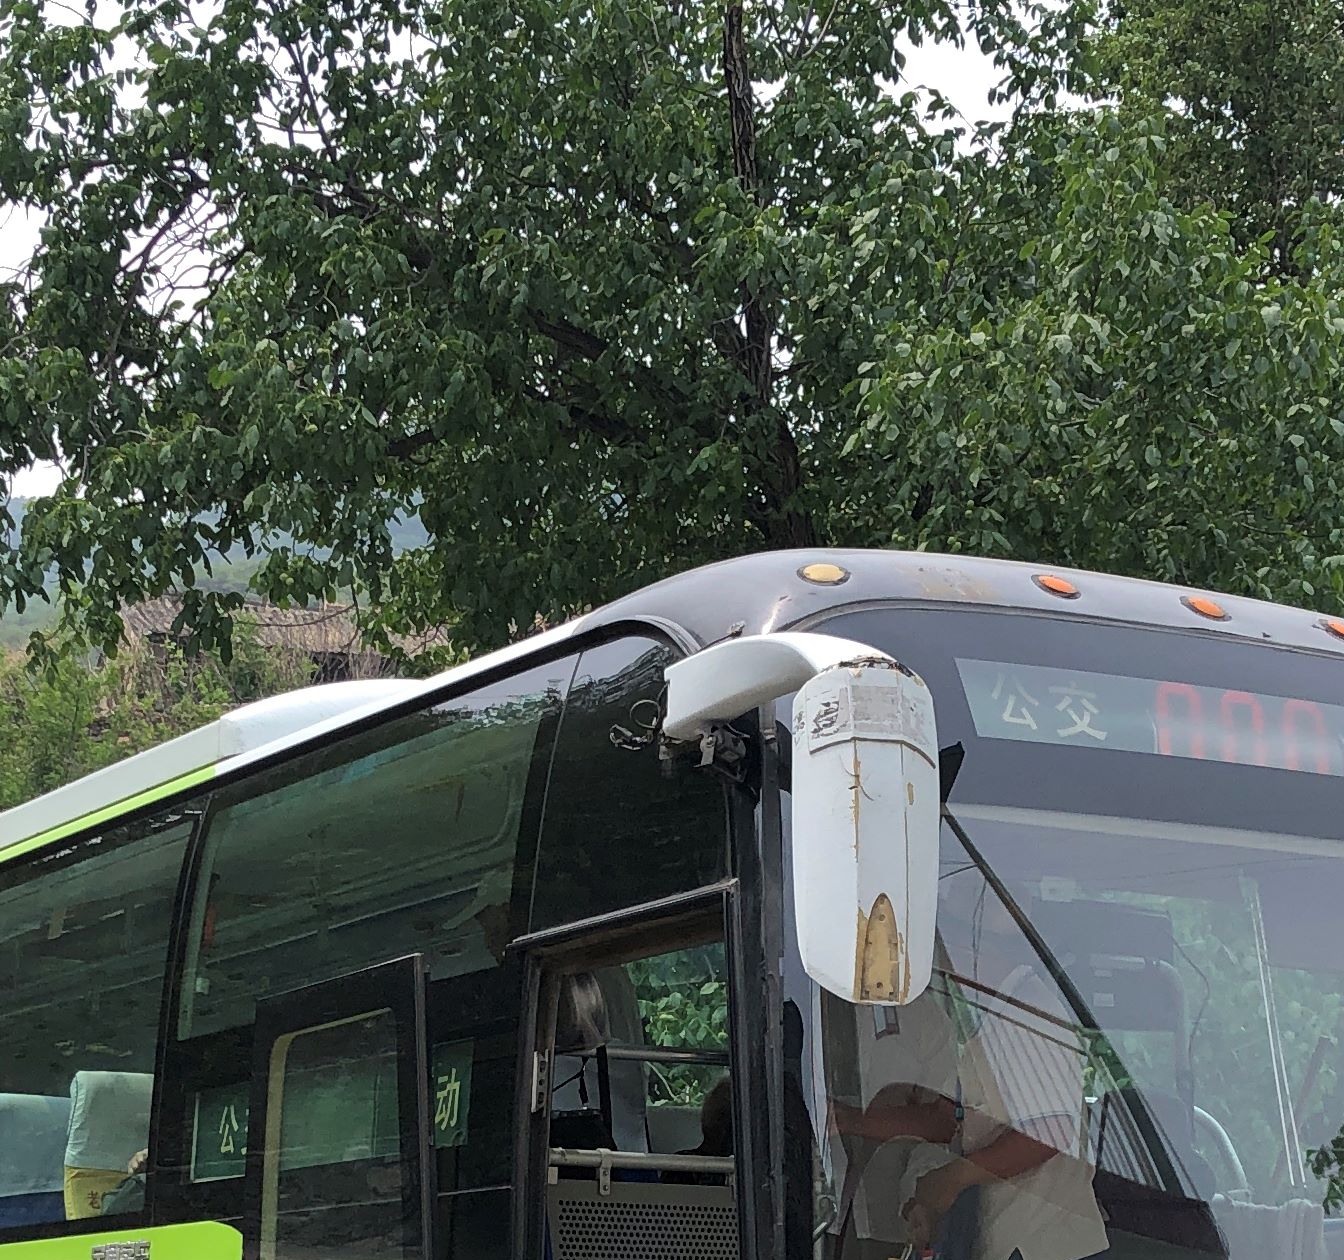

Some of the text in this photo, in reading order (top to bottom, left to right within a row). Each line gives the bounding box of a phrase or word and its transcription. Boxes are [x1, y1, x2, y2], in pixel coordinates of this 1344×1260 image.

[992, 673, 1108, 741] 公交
[218, 1067, 461, 1155] 公 动
